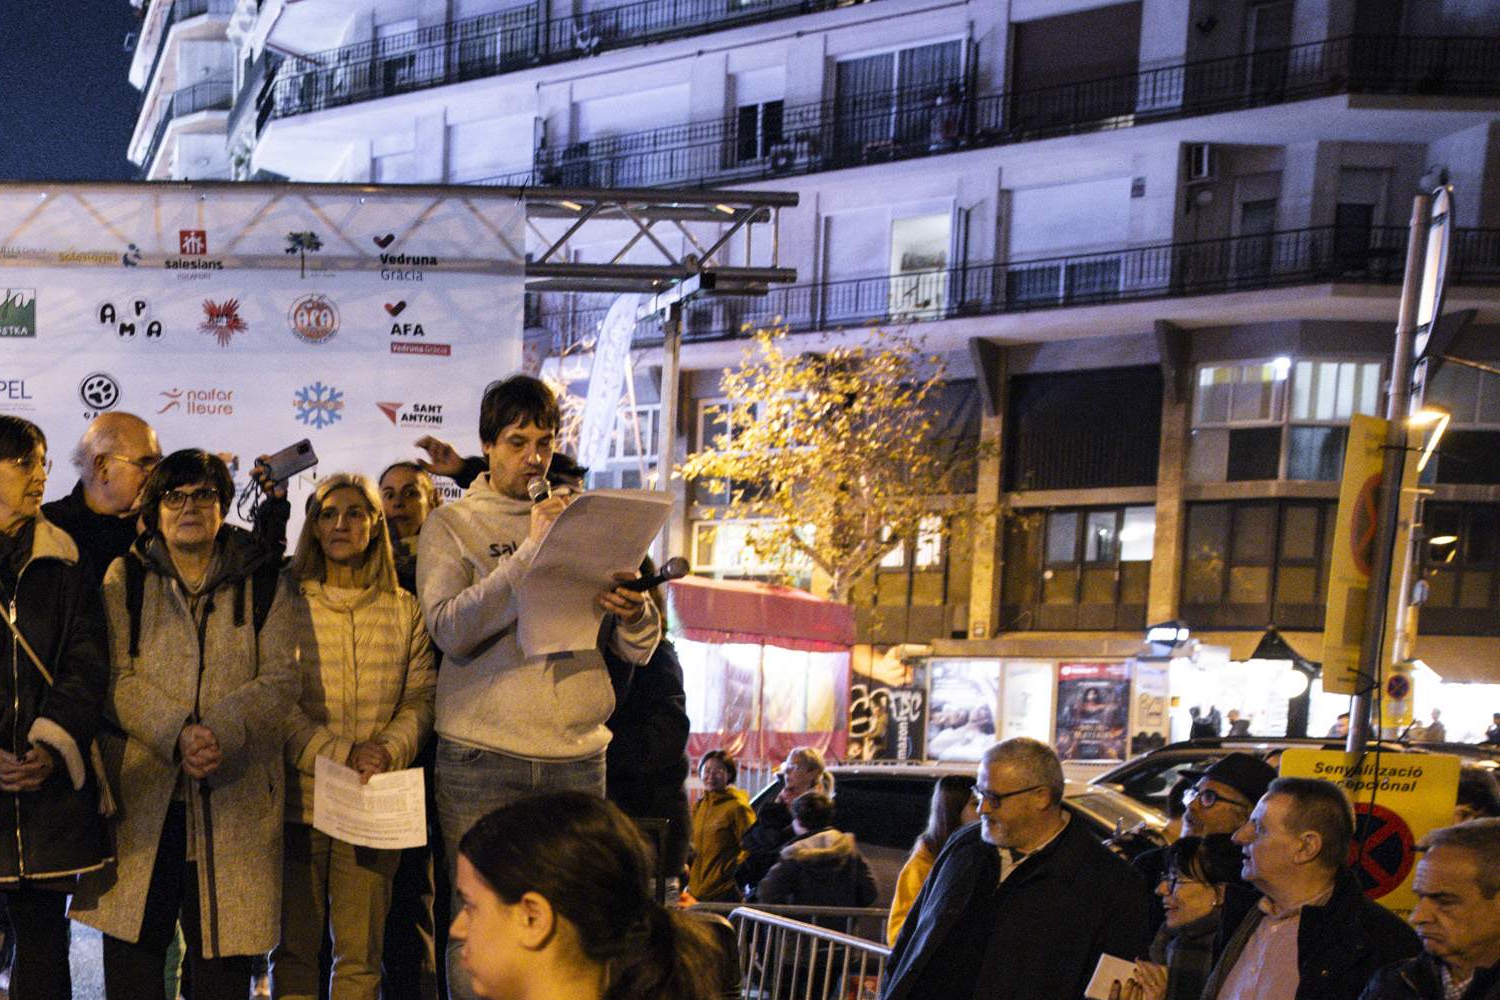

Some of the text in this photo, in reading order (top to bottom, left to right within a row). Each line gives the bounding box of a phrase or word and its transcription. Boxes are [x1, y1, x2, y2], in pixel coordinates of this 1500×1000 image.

[164, 258, 224, 271] salesians
[379, 253, 438, 266] Vedruna
[380, 268, 424, 282] Gràcia
[390, 323, 425, 337] AFA
[412, 403, 444, 415] SANT
[400, 412, 444, 426] ANTONI
[435, 486, 462, 499] TONI
[1314, 761, 1423, 779] Senyalizació
